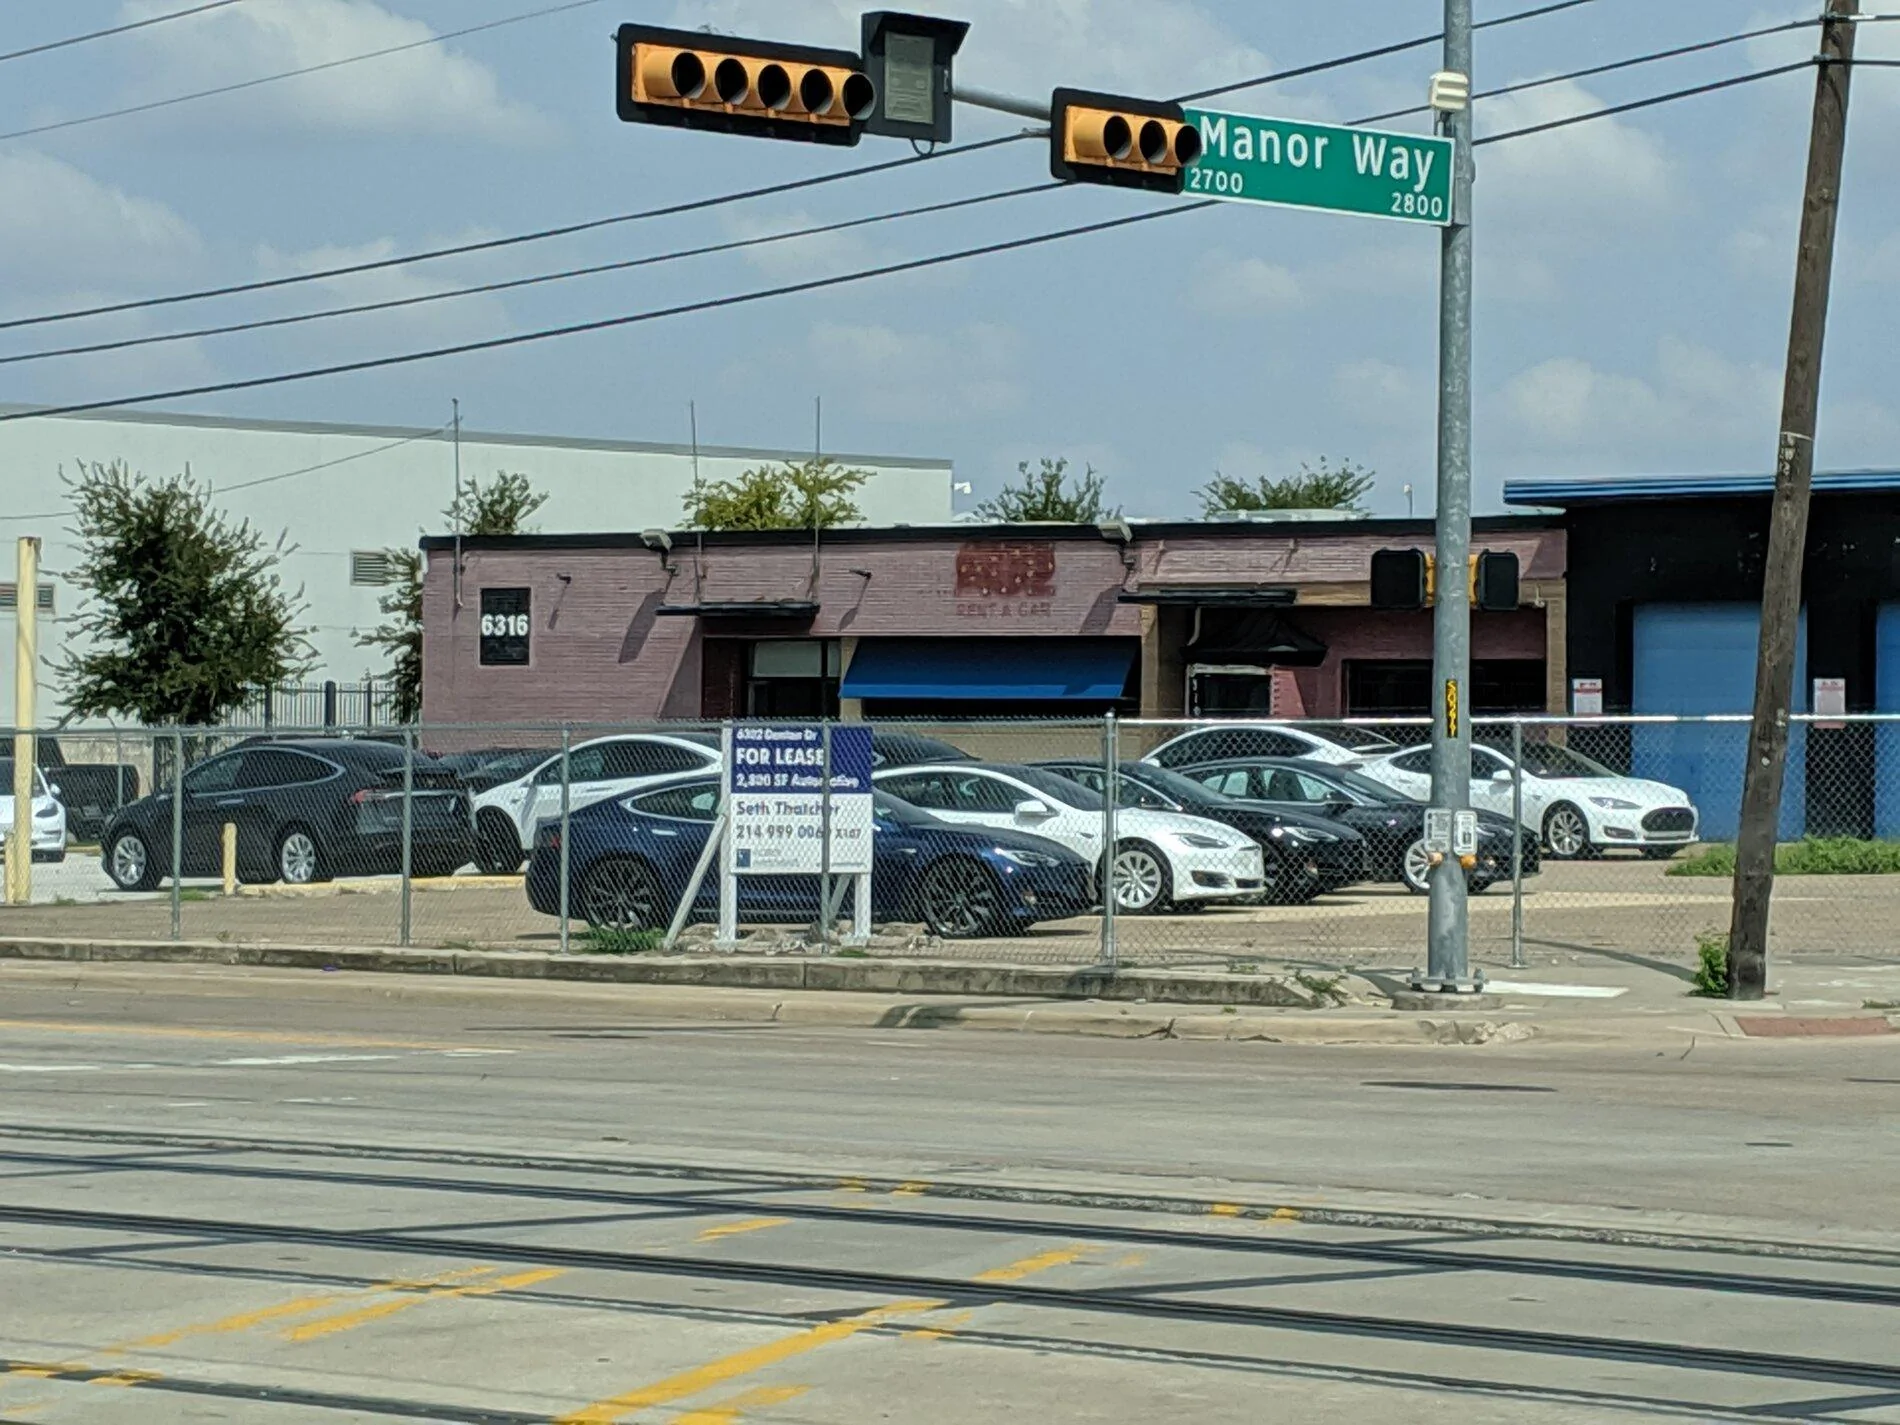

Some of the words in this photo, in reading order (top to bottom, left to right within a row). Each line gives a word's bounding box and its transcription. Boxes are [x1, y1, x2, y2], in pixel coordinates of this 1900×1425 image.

[1199, 115, 1329, 169] Manor
[1352, 133, 1434, 192] Way
[1190, 167, 1243, 194] 2700
[1391, 192, 1443, 217] 2800
[481, 613, 528, 636] 6316
[736, 748, 770, 765] FOR
[775, 748, 824, 765] LEASE
[774, 774, 789, 786] SF
[736, 801, 770, 815] Seth
[775, 801, 840, 815] Thatchr
[736, 825, 762, 839] 214
[767, 825, 793, 839] 999
[798, 825, 831, 839] 006
